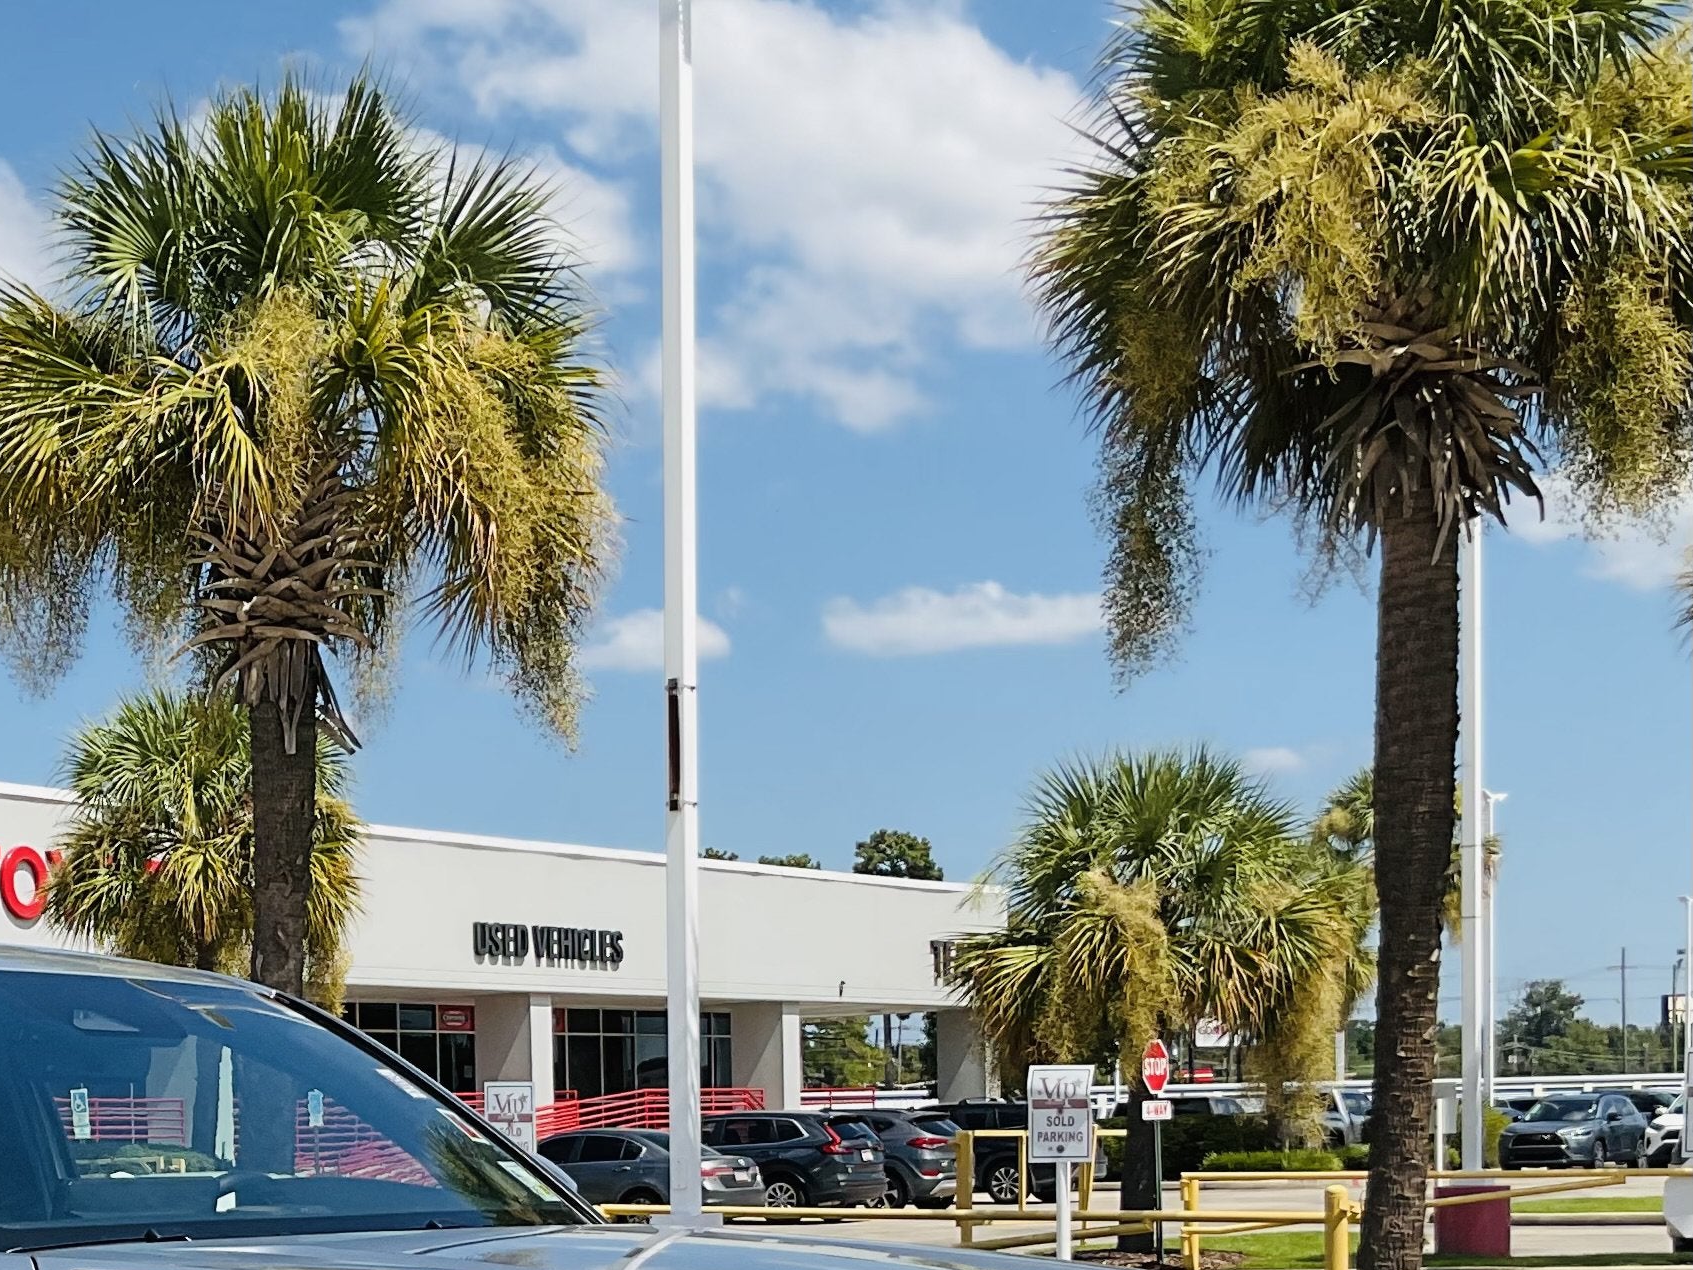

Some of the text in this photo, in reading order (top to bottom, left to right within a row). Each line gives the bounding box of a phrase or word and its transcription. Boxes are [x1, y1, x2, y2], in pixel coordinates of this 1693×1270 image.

[473, 922, 623, 963] USED VEHICLES
[1144, 1057, 1167, 1076] STOP
[1146, 1104, 1168, 1116] 4-WAY
[1046, 1115, 1076, 1127] SOLD
[1037, 1131, 1084, 1143] PARKING
